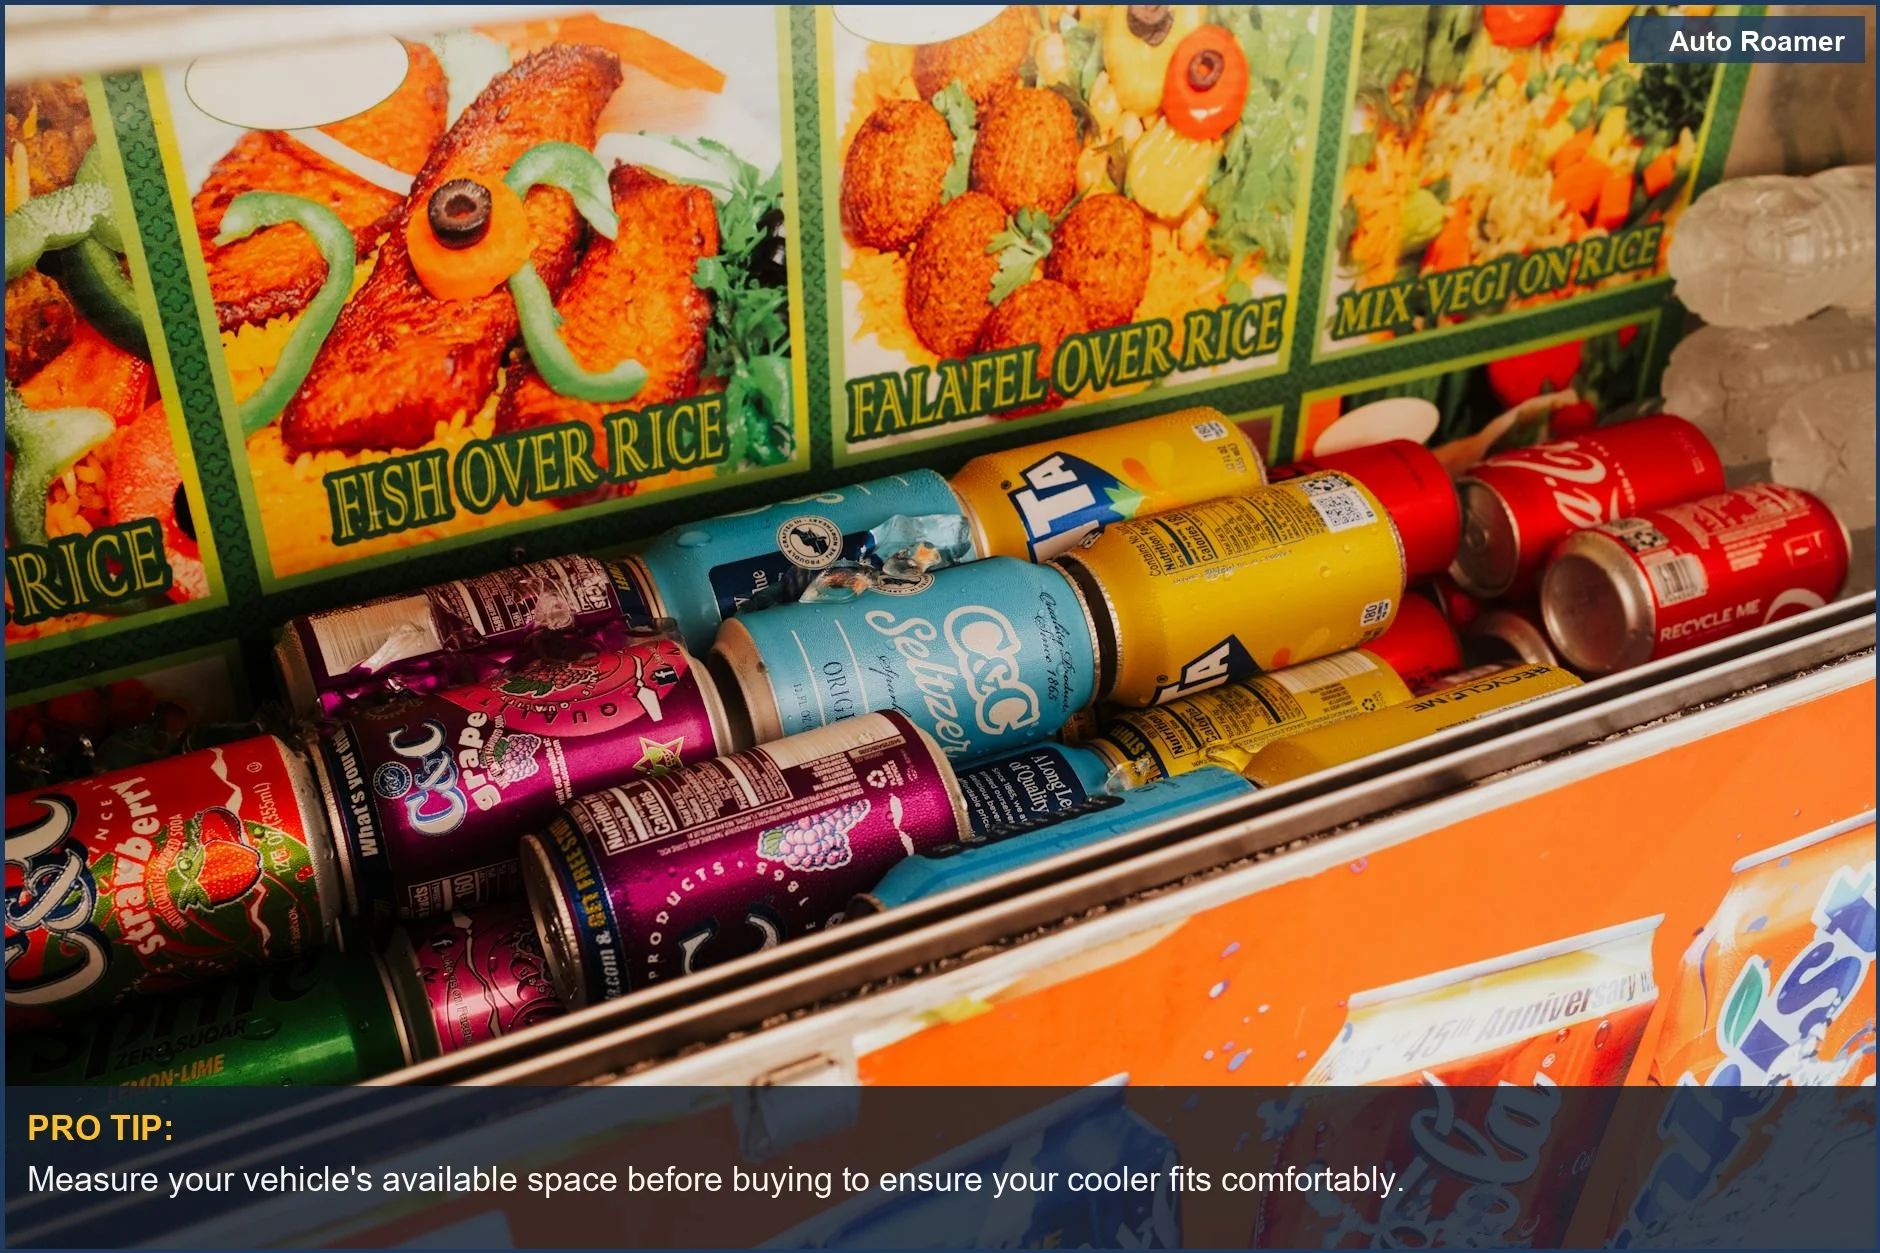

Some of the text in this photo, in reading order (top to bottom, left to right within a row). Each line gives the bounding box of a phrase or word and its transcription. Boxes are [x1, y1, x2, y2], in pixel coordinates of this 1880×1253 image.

[1338, 226, 1662, 336] MIX VEGI ON RICE
[852, 299, 1283, 436] FALAFEL OVER RICE
[331, 399, 725, 538] FISH OVER RICE
[780, 522, 795, 548] CRAFTED
[785, 547, 822, 565] PROUDLY
[1149, 535, 1177, 572] Nutrition
[1185, 525, 1214, 562] Calories
[8, 525, 166, 618] RICE
[1136, 540, 1162, 577] Contains
[1039, 592, 1070, 648] Quality
[1363, 603, 1379, 624] 180
[1660, 598, 1762, 643] RECYCLE ME
[943, 605, 1041, 735] C&C
[1033, 615, 1059, 702] Since 1865
[823, 661, 856, 721] ORIGI
[864, 609, 972, 759] Seltzer
[1450, 664, 1554, 702] RECYCLE
[1404, 697, 1451, 714] ME
[1151, 714, 1185, 755] Nutrition
[387, 718, 468, 837] C&C
[458, 711, 501, 812] grape
[1031, 754, 1049, 765] A
[1038, 760, 1064, 792] Long
[253, 782, 284, 833] (355mL)
[340, 754, 379, 858] What's your
[1003, 782, 1018, 801] 1865,
[1009, 761, 1050, 814] of Quality
[591, 800, 626, 851] Nutrition
[621, 818, 638, 845] Serving
[639, 792, 672, 836] Calories
[986, 799, 1002, 824] bever
[109, 776, 166, 956] strawberry
[454, 874, 475, 898] 160
[566, 851, 596, 891] FREE
[581, 892, 607, 928] GET
[647, 861, 726, 980] PRODUCTS
[595, 930, 613, 945] &
[1403, 1016, 1476, 1063] 45th
[1474, 972, 1640, 1043] Anniversary
